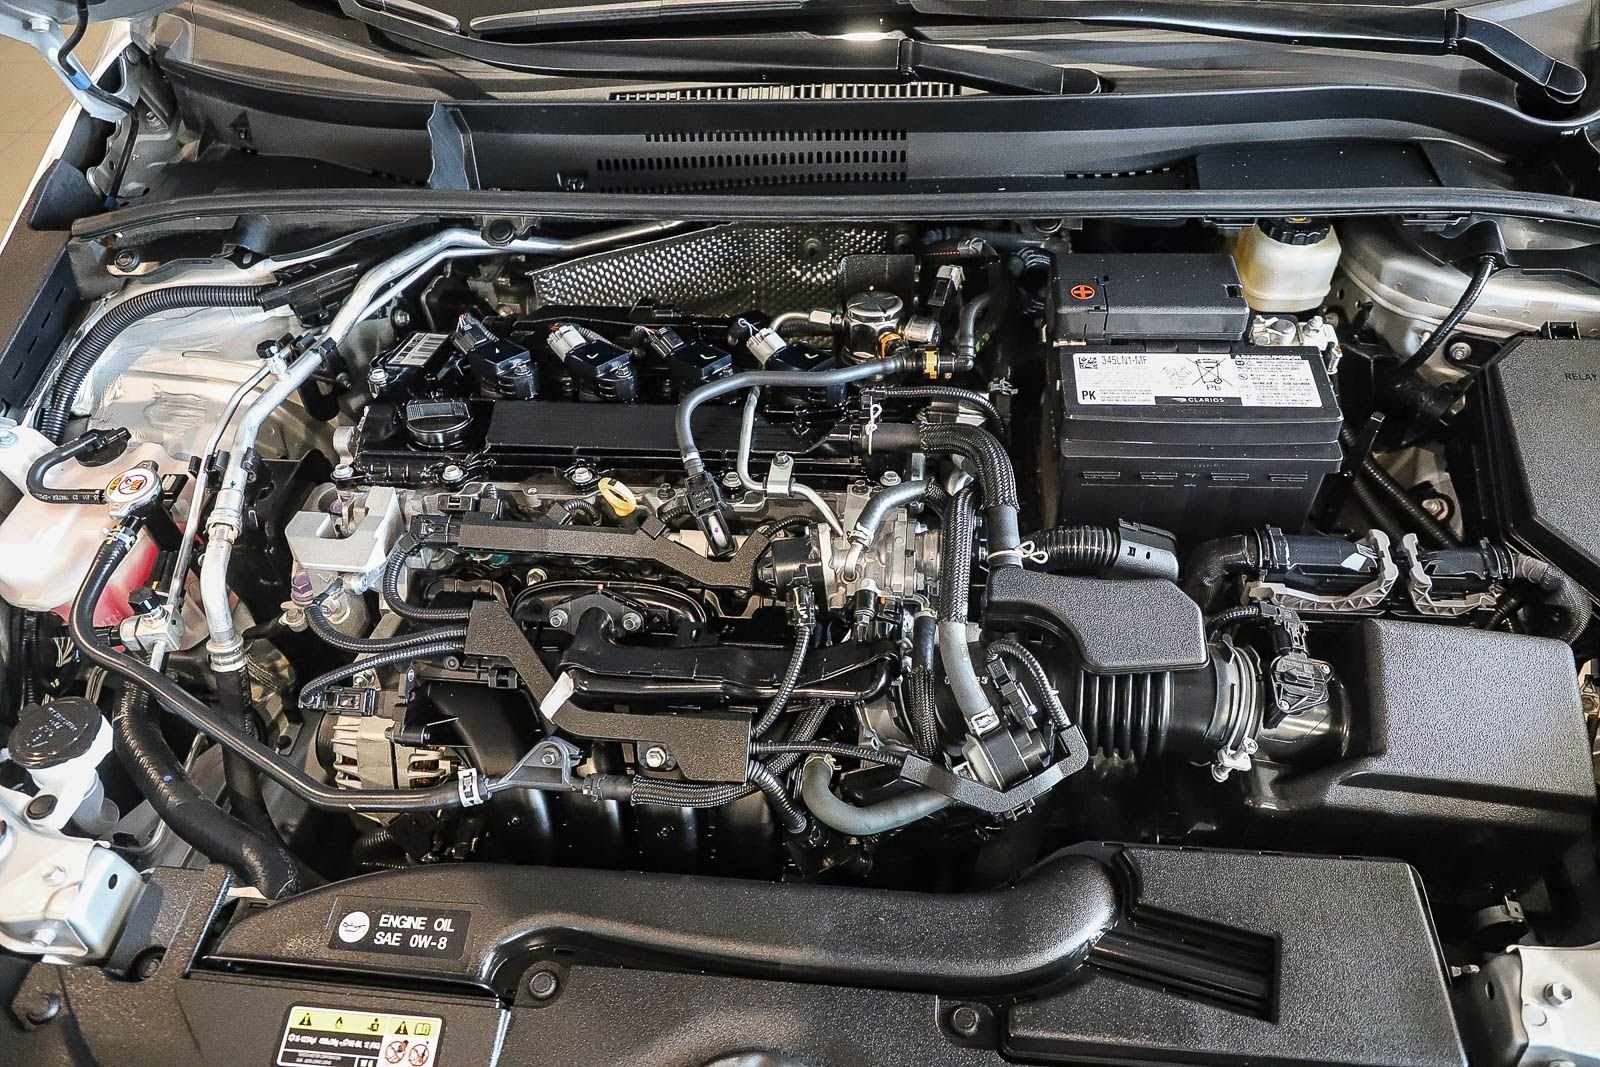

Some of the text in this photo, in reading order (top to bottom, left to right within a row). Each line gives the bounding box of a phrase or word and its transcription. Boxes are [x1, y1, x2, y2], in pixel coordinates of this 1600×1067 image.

[1101, 355, 1148, 365] 345LN1-MF
[1564, 372, 1598, 381] RELAY
[1206, 384, 1222, 392] Pb
[1081, 390, 1096, 401] PK
[379, 914, 455, 933] ENGINE OIL
[373, 931, 448, 950] SAE 0W-8
